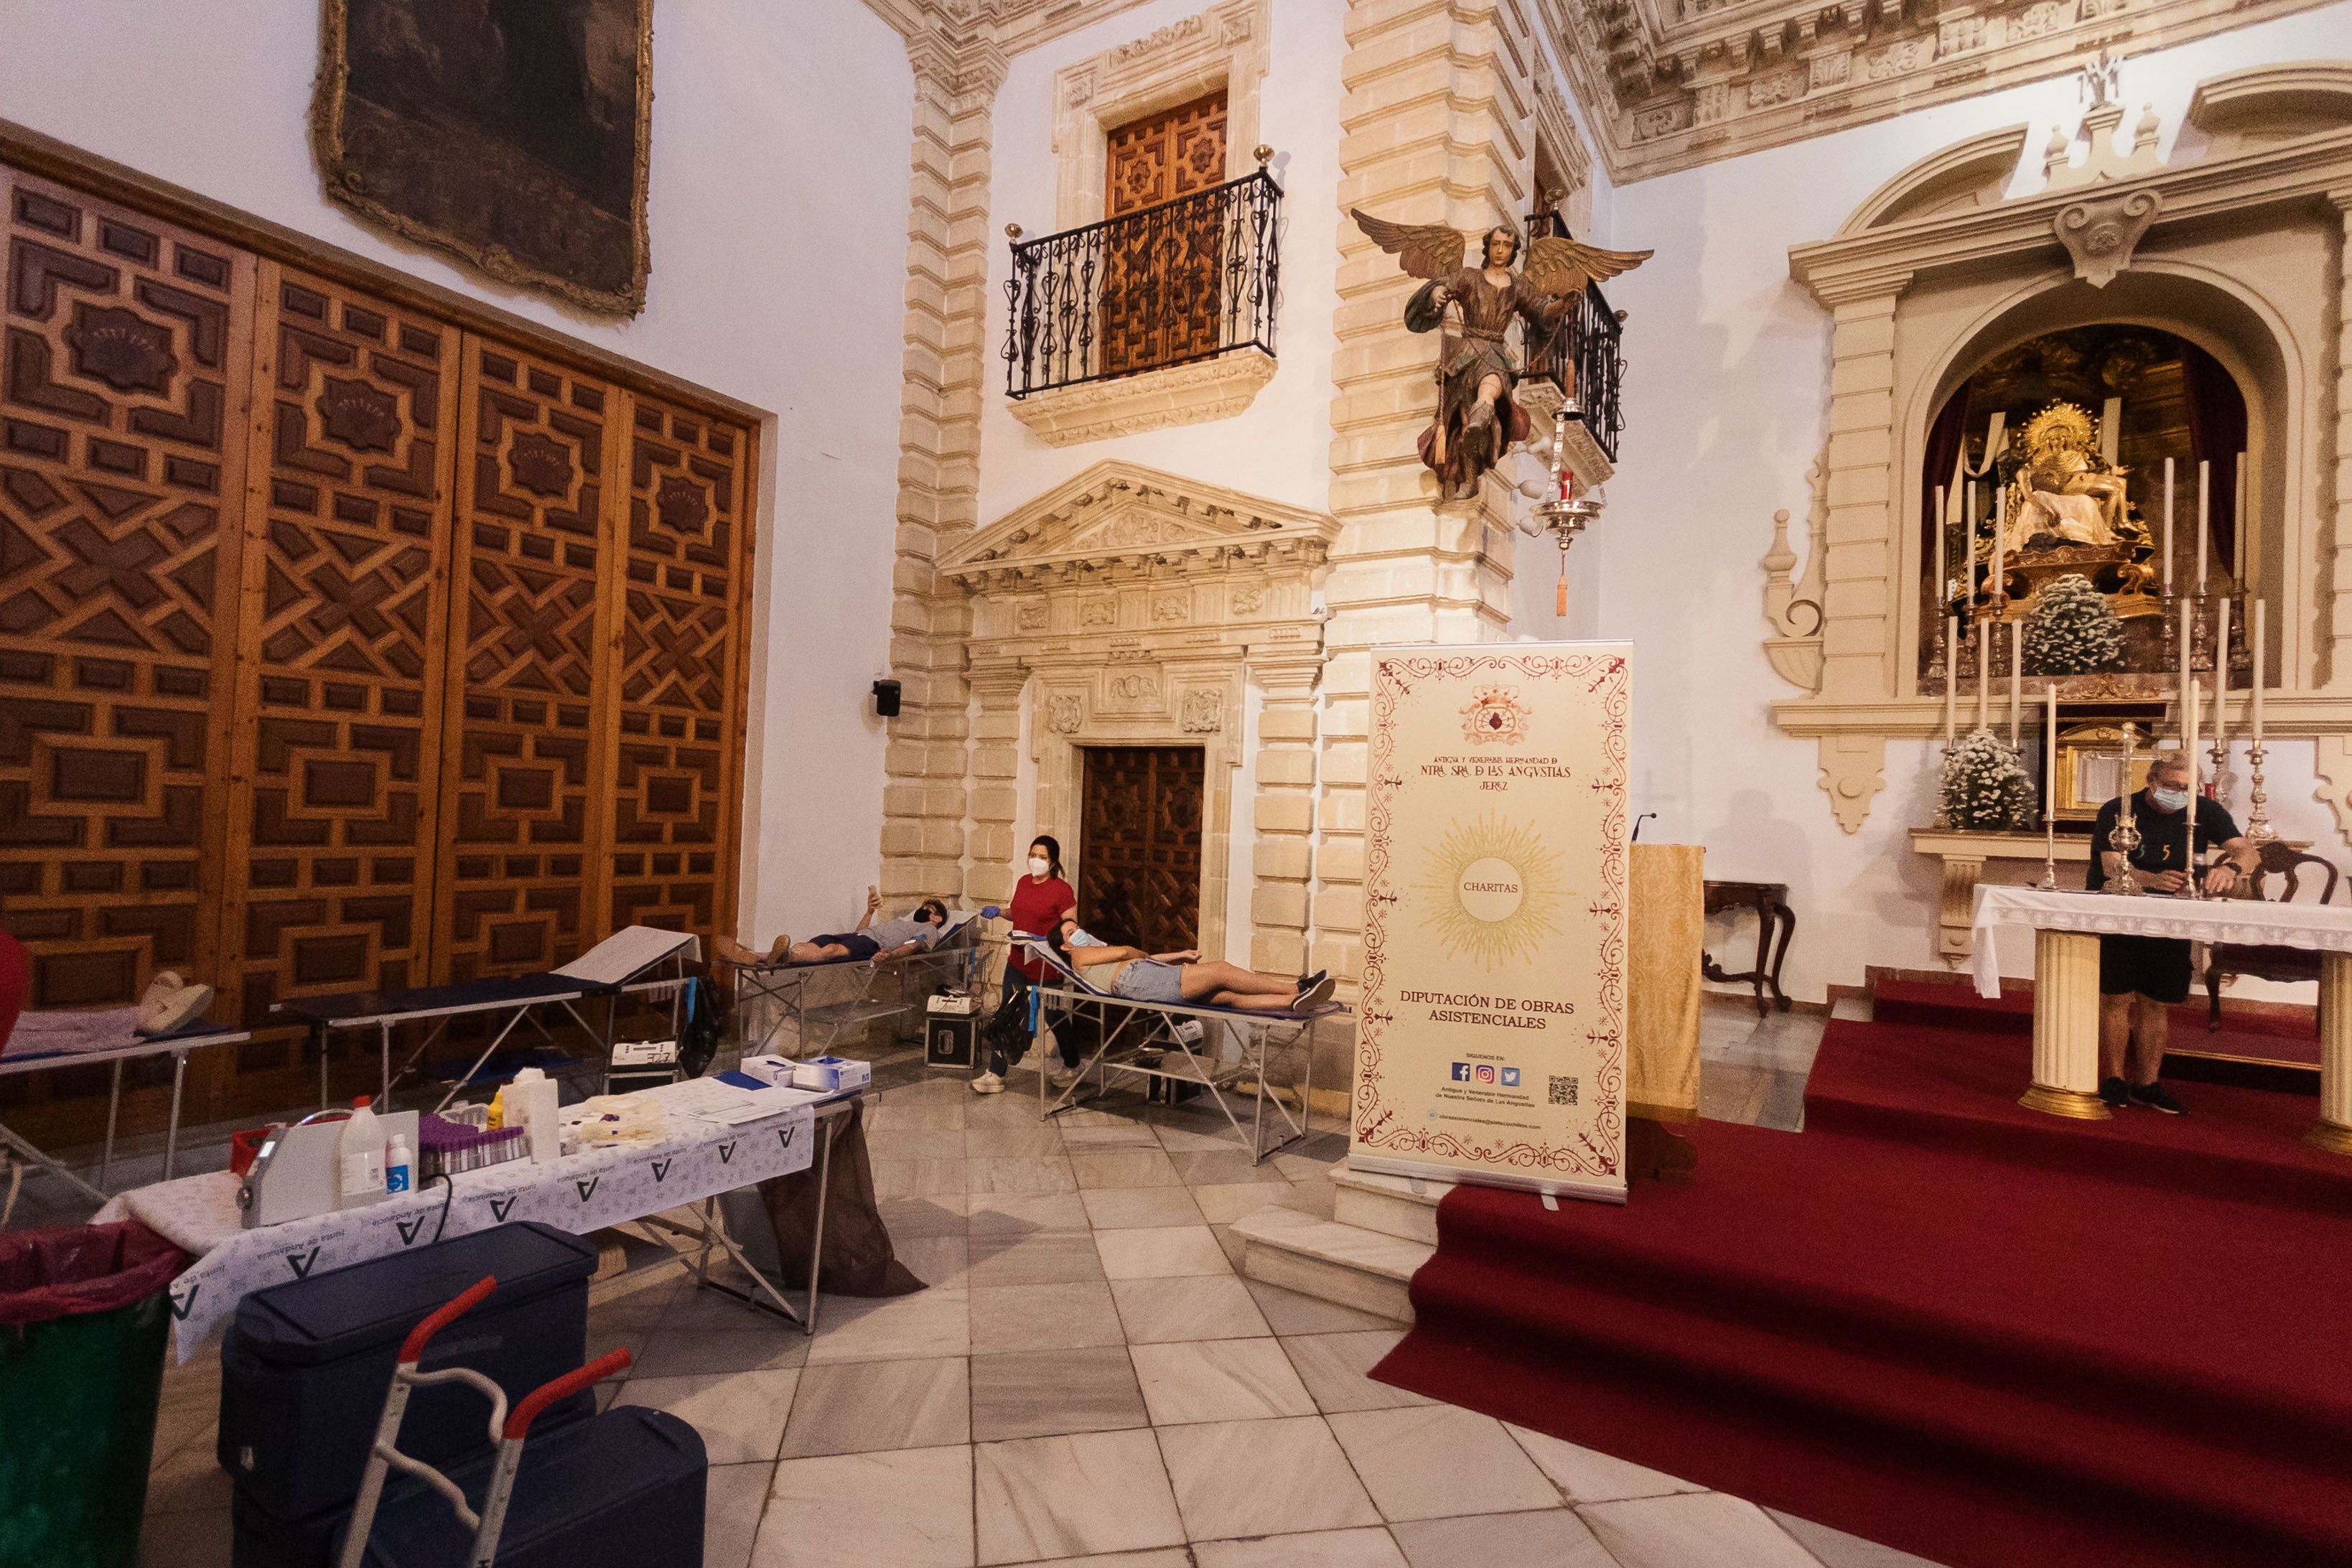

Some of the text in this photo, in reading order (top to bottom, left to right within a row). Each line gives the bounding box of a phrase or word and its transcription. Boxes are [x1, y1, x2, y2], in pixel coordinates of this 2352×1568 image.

[1488, 765, 1503, 776] LAS
[1508, 766, 1572, 778] ANGVSTIAS
[1480, 781, 1508, 791] JEREZ
[2162, 844, 2171, 861] 5
[1464, 882, 1518, 893] CHARITAS
[1400, 990, 1574, 1014] DIPUTACIÓN DE OBRAS
[1429, 1009, 1546, 1030] ASISTENCIALES
[1497, 1091, 1529, 1101] Hermandad
[426, 1202, 447, 1212] unta
